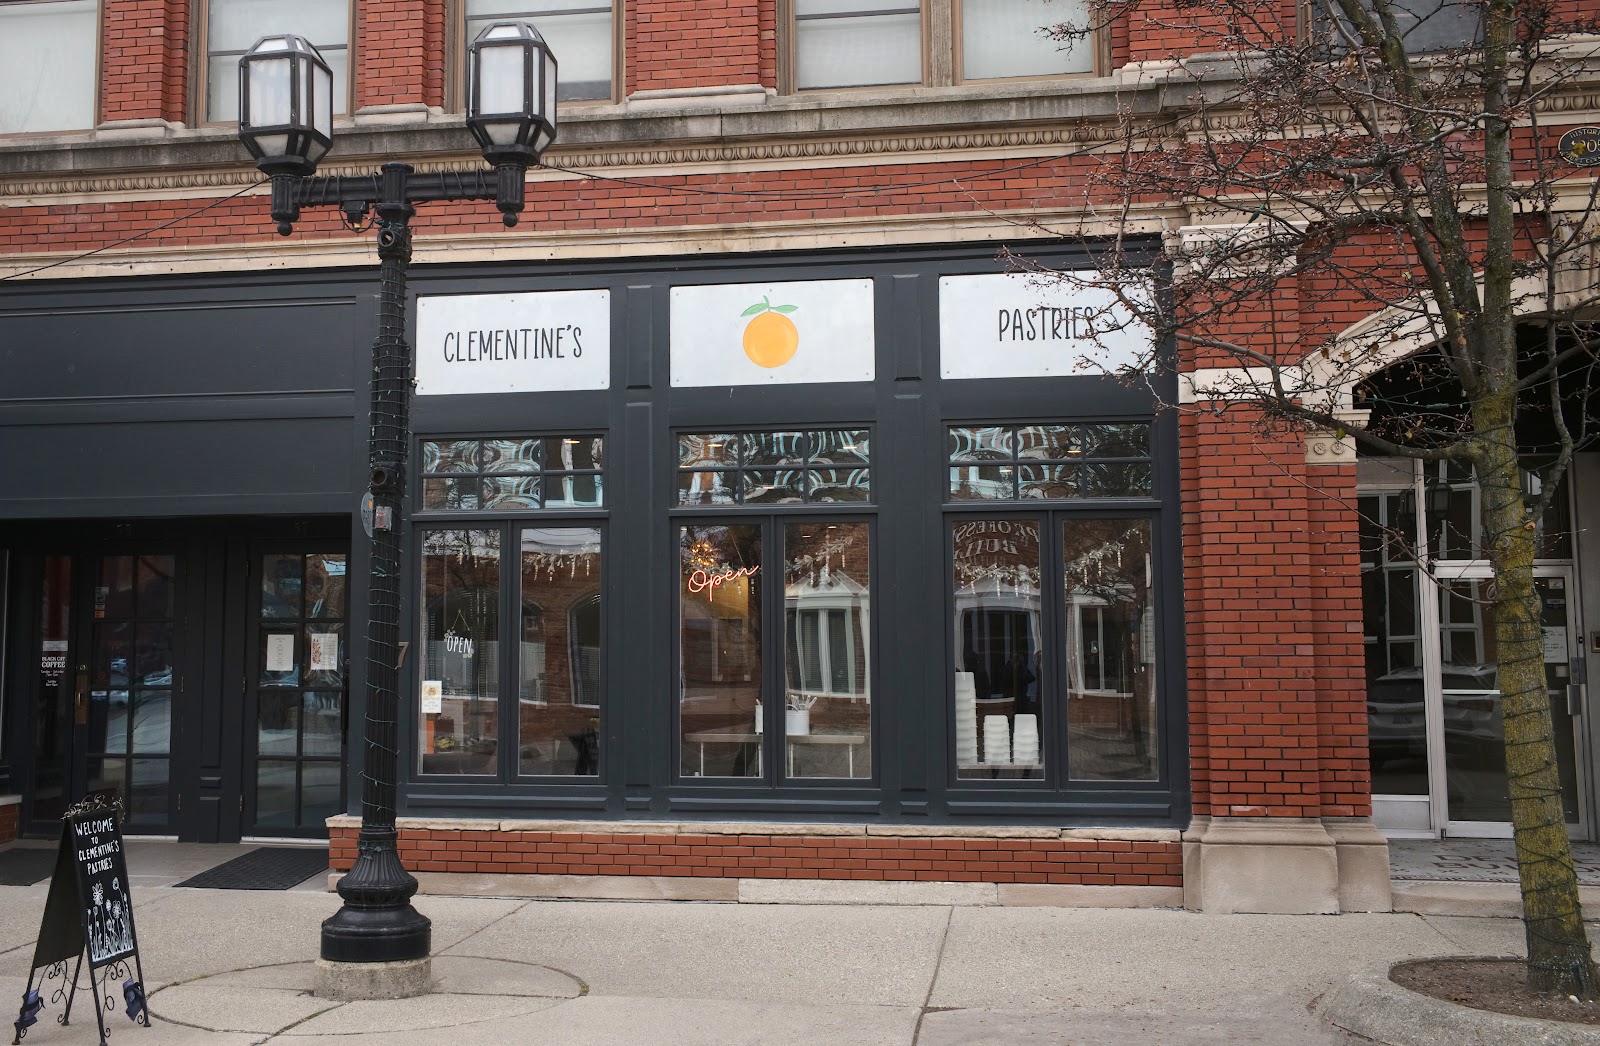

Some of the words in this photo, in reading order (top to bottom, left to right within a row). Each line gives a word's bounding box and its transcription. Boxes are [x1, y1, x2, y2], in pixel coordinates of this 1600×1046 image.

[998, 306, 1094, 341] PASTRIES
[443, 324, 582, 363] CLEMENTINE'S
[688, 564, 760, 602] Open
[446, 635, 473, 653] OPEN
[74, 817, 114, 836] WELCOME
[78, 839, 120, 862] CLEMENTINE'S
[90, 836, 99, 845] TO
[87, 857, 113, 875] PASTRIES
